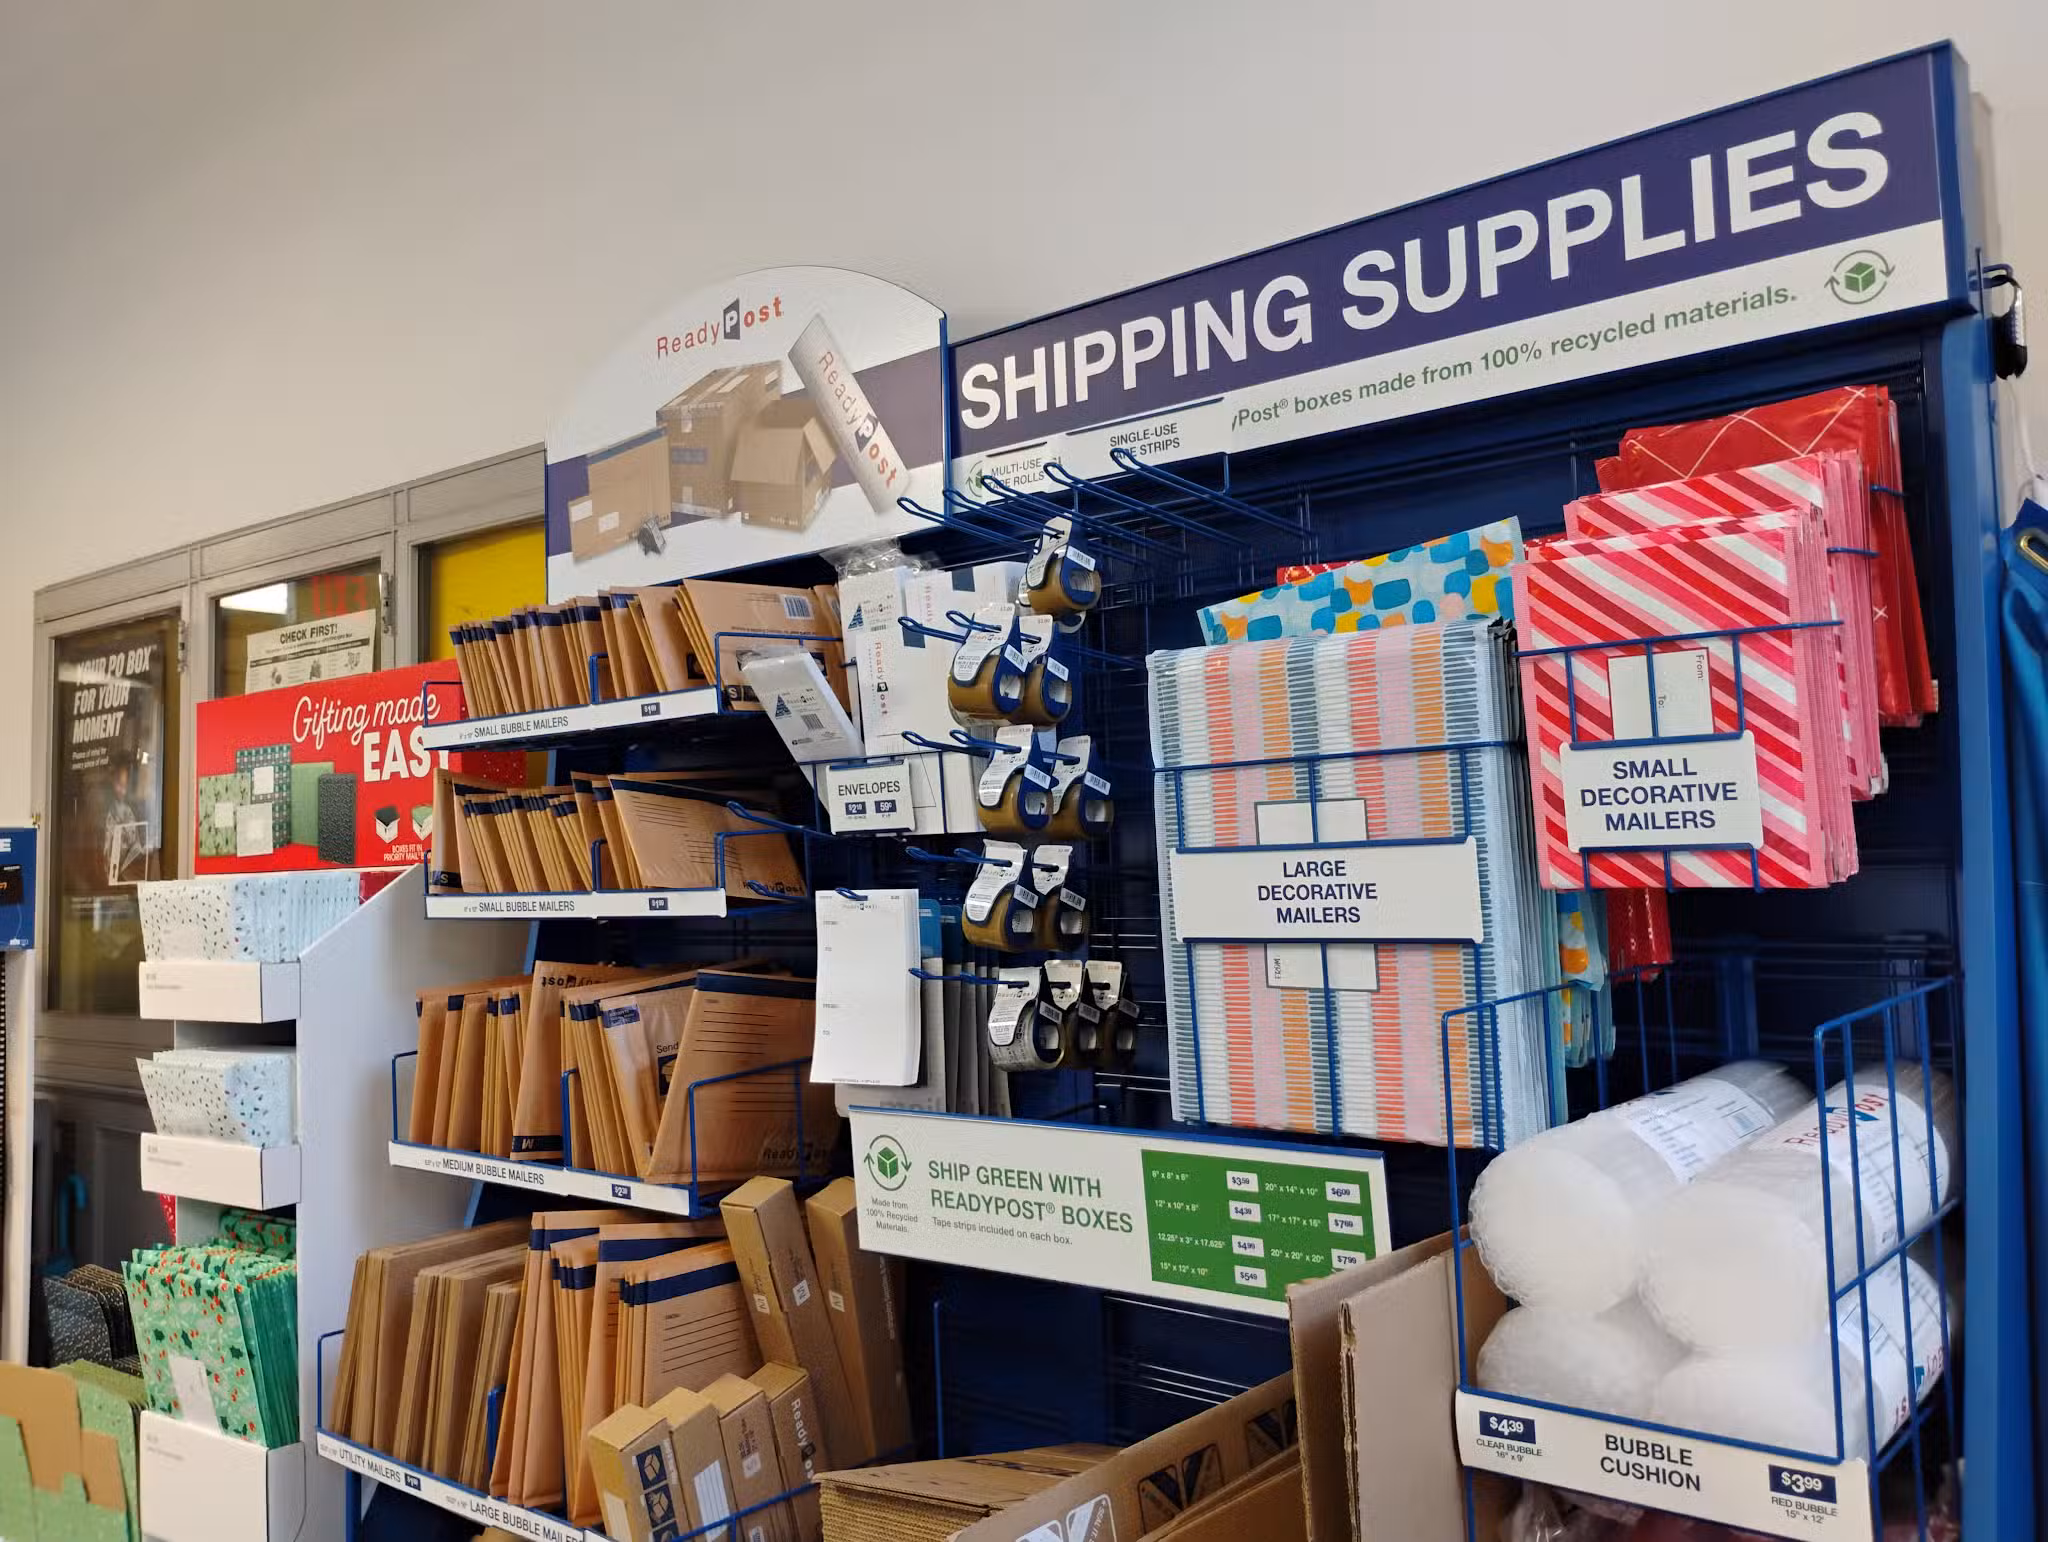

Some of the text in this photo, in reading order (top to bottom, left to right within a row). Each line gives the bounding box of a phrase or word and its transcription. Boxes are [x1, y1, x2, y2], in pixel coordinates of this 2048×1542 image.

[961, 111, 1889, 430] SHIPPING SUPPLIES
[656, 296, 784, 360] ReadyPost
[1295, 386, 1352, 413] boxes
[1359, 373, 1416, 399] made
[1421, 360, 1473, 385] from
[1480, 341, 1543, 372] 100%
[1550, 313, 1656, 355] recycled
[1664, 285, 1798, 330] materials.
[818, 350, 897, 489] ReadyPost
[1109, 422, 1179, 448] SINGLE-USE
[1113, 437, 1181, 460] APE STRIPS
[990, 457, 1042, 478] MULTI-USE
[1013, 470, 1045, 488] ROLLS
[280, 628, 307, 645] CHECK
[310, 623, 338, 639] FIRST!
[77, 657, 106, 686] YOUR
[107, 652, 125, 678] PO
[1696, 654, 1705, 682] From:
[74, 681, 131, 716] FOR YOUR
[1657, 694, 1666, 709] To:
[73, 711, 124, 745] MOMENT
[293, 688, 441, 751] Gifting made
[474, 725, 500, 738] SMALL
[501, 720, 532, 735] BUBBLE
[533, 715, 569, 731] MAILERS
[1612, 757, 1698, 780] SMALL
[838, 780, 901, 797] ENVELOPES
[1580, 781, 1738, 808] DECORATIVE
[1605, 809, 1716, 832] MAILERS
[383, 852, 405, 862] PRIORITY
[1282, 859, 1347, 879] LARGE
[1257, 882, 1378, 901] DECORATIVE
[479, 901, 505, 913] SMALL
[506, 901, 537, 912] BUBBLE
[539, 900, 575, 912] MAILERS
[1275, 906, 1361, 924] MAILERS
[656, 1041, 680, 1054] Send
[443, 1158, 474, 1173] MEDIUM
[475, 1163, 507, 1179] BUBBLE
[508, 1169, 545, 1185] MAILERS
[928, 1160, 1102, 1199] SHIP GREEN WITH
[1265, 1182, 1278, 1192] 20"
[1284, 1184, 1297, 1194] 14"
[1306, 1187, 1319, 1196] 10"
[866, 1207, 919, 1223] 100% Recycled
[871, 1196, 909, 1211] Made from
[931, 1189, 1133, 1234] READYPOST® BOXES
[1155, 1200, 1165, 1209] 12"
[1268, 1213, 1280, 1222] 17"
[1288, 1215, 1300, 1225] 17"
[932, 1216, 1073, 1246] Tape strips included on each box.
[1270, 1248, 1283, 1258] 20"
[1290, 1250, 1303, 1261] 20"
[1311, 1254, 1324, 1263] 20"
[1178, 1264, 1190, 1274] 12"
[1489, 1415, 1525, 1436] $439
[791, 1398, 817, 1479] ReadyPos
[1476, 1437, 1543, 1457] CLEAR BUBBLE
[1604, 1433, 1694, 1467] BUBBLE
[339, 1447, 366, 1468] UTILITY
[367, 1459, 401, 1483] MAILERS
[1600, 1455, 1701, 1493] CUSHION
[1780, 1471, 1823, 1494] $399
[469, 1499, 500, 1522] LARGE
[502, 1511, 541, 1537] BUBBLE
[1771, 1495, 1839, 1518] RED BUBBLE
[1785, 1507, 1800, 1520] 15"
